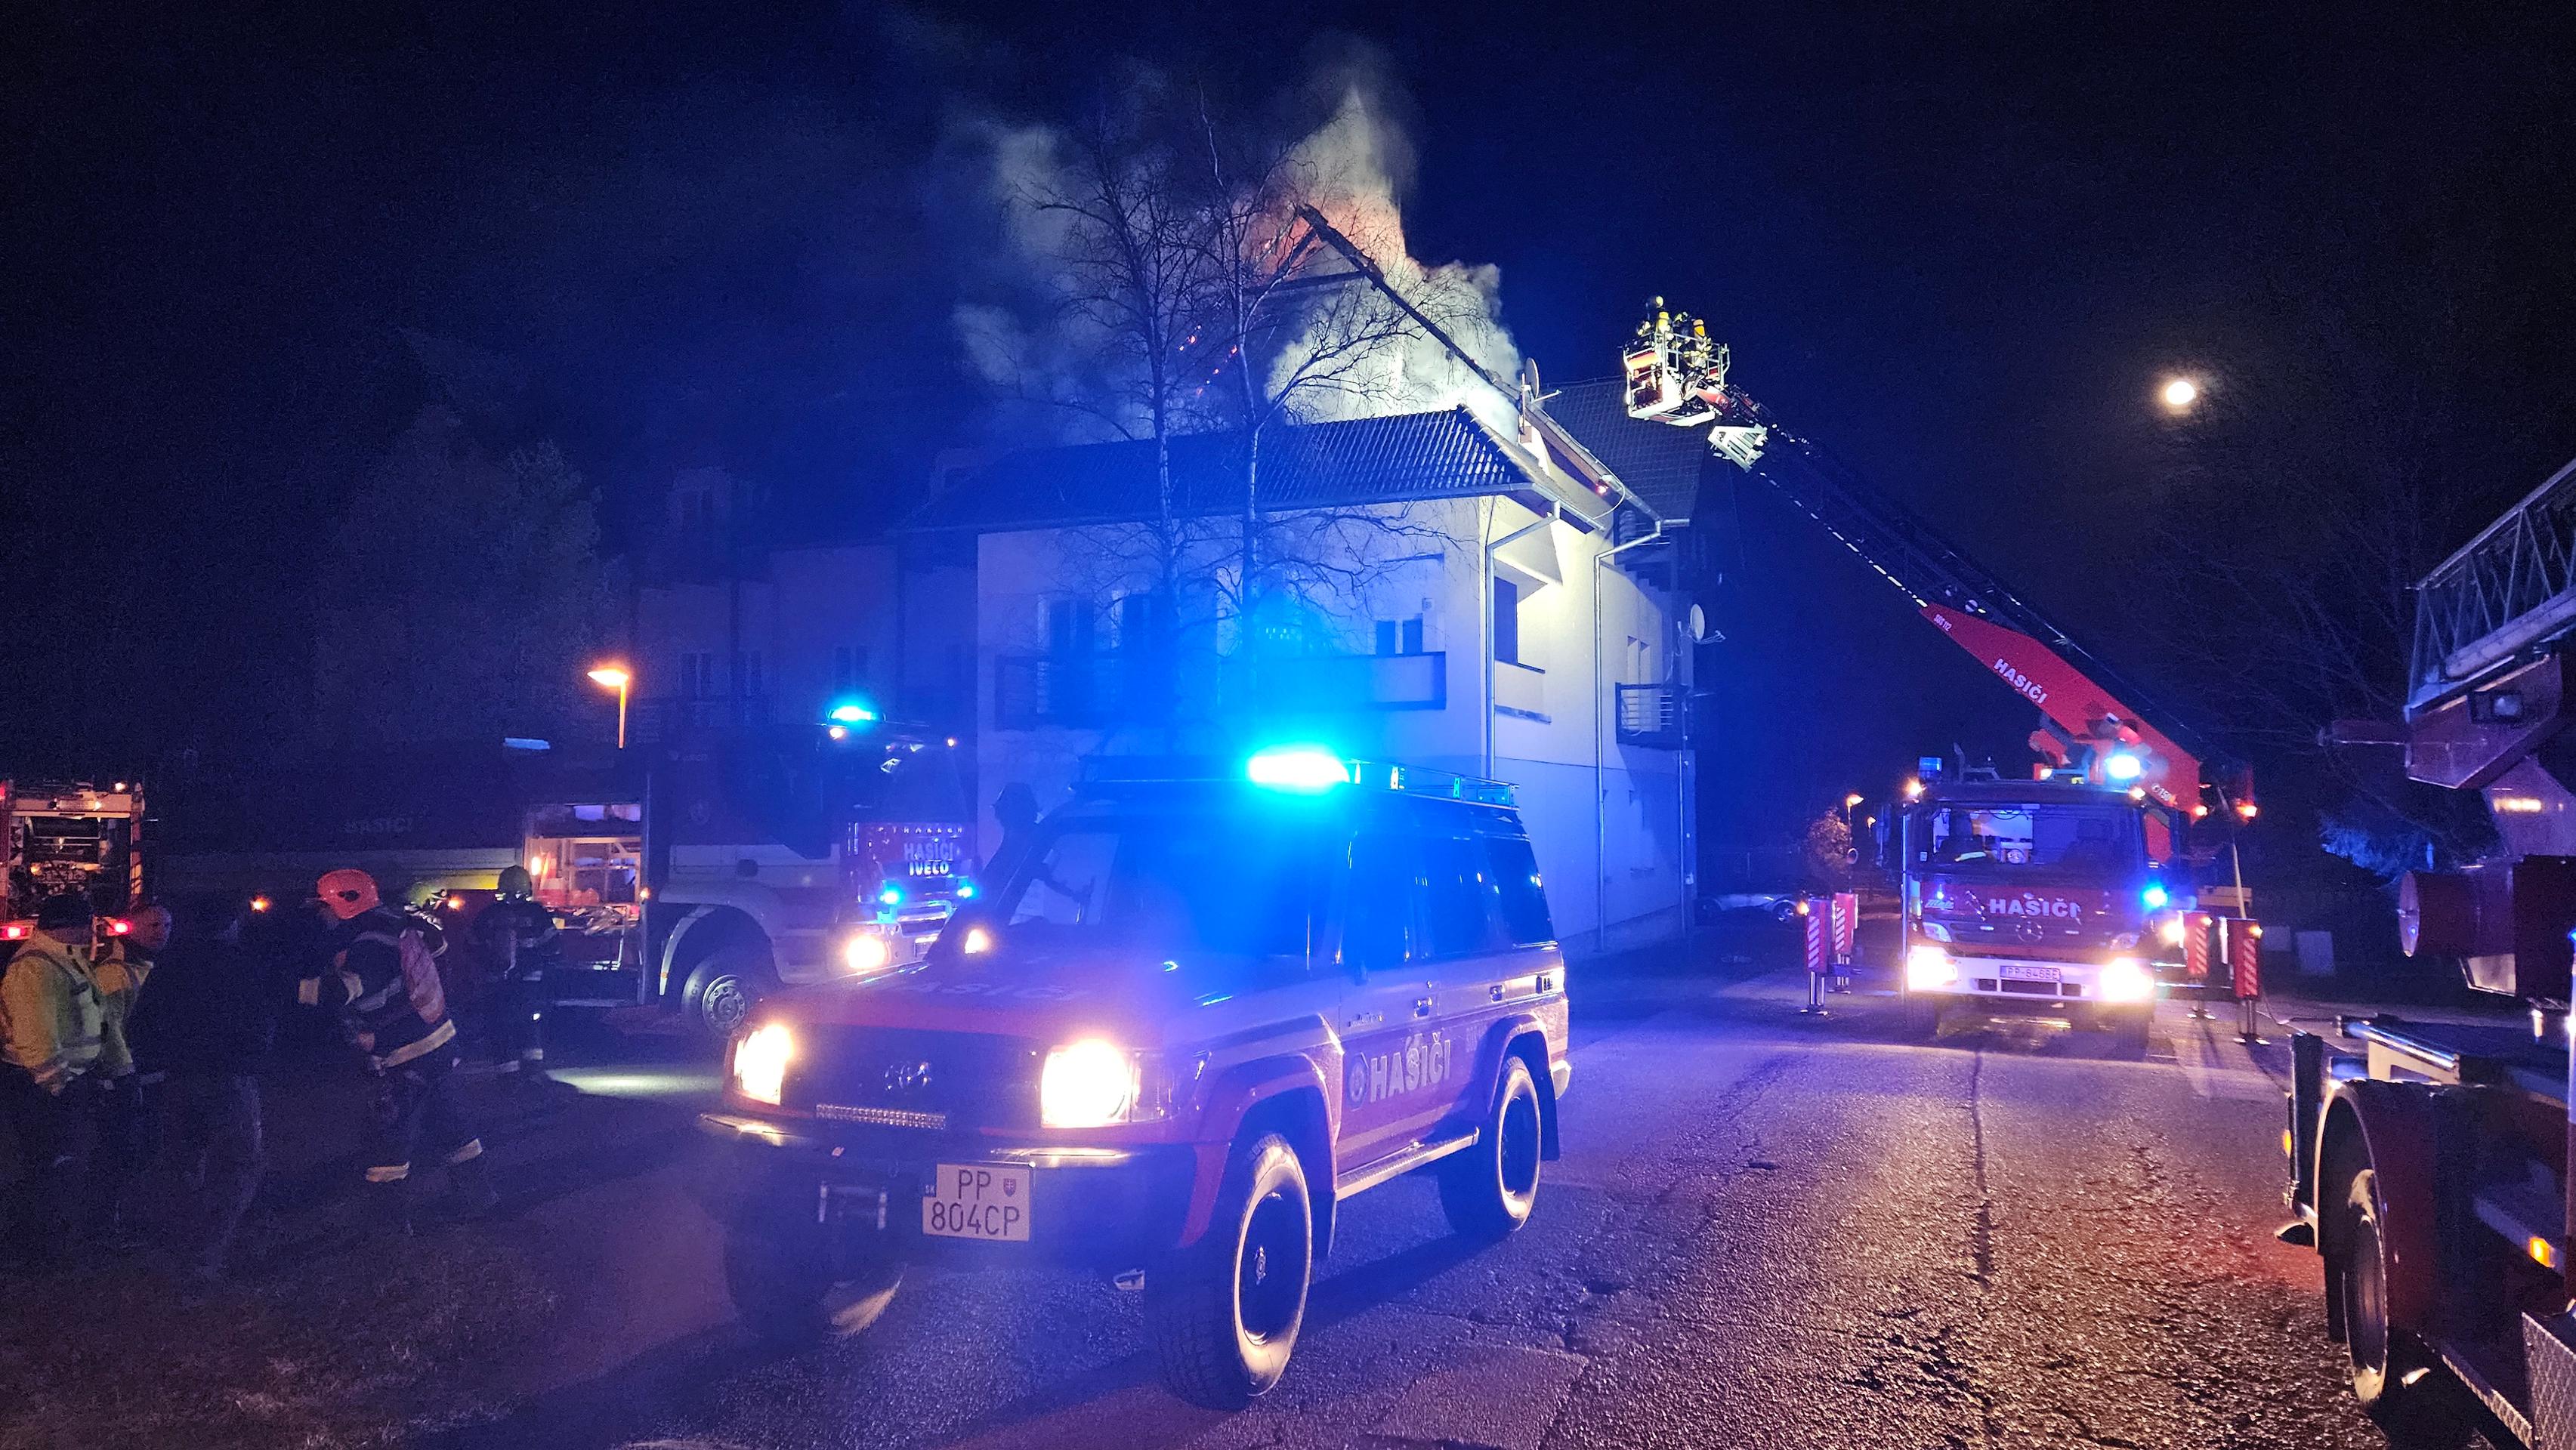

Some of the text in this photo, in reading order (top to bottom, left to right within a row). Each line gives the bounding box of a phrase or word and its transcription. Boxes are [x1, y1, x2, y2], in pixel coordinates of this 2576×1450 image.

[1994, 658, 2048, 704] HASIČI
[909, 861, 950, 876] IVECO
[1370, 1032, 1451, 1103] HASIČI
[925, 1185, 935, 1194] SK
[958, 1169, 991, 1200] PP
[931, 1202, 1020, 1236] 804CP
